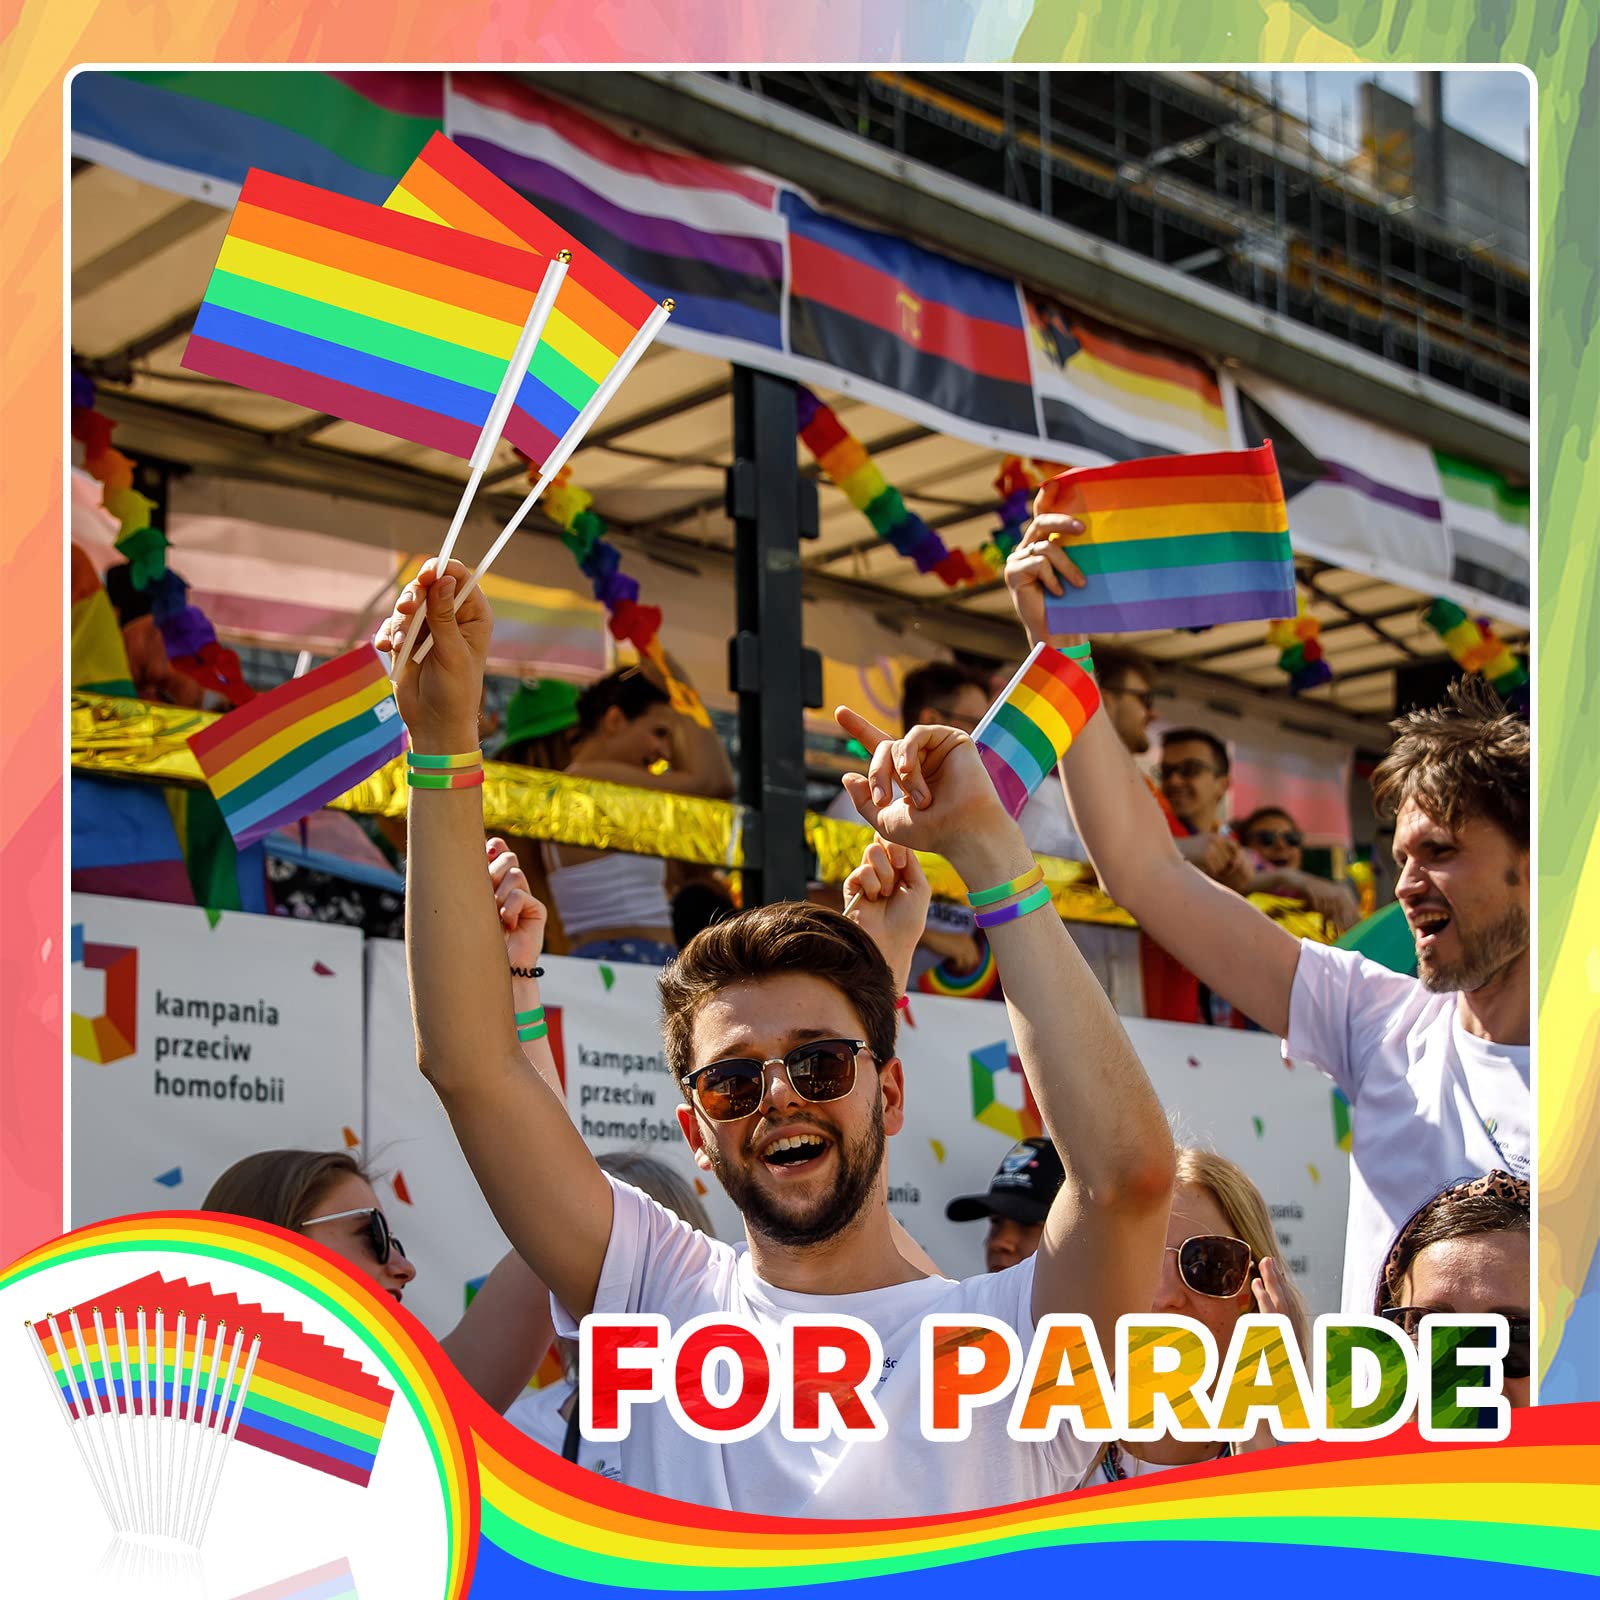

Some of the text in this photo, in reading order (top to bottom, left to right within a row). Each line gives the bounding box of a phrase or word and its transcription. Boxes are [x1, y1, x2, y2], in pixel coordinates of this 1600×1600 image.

[155, 988, 280, 1027] kampania
[155, 1034, 252, 1063] przeciw
[578, 1042, 669, 1075] kampani
[154, 1069, 285, 1104] homofobii
[580, 1083, 656, 1107] przeciw
